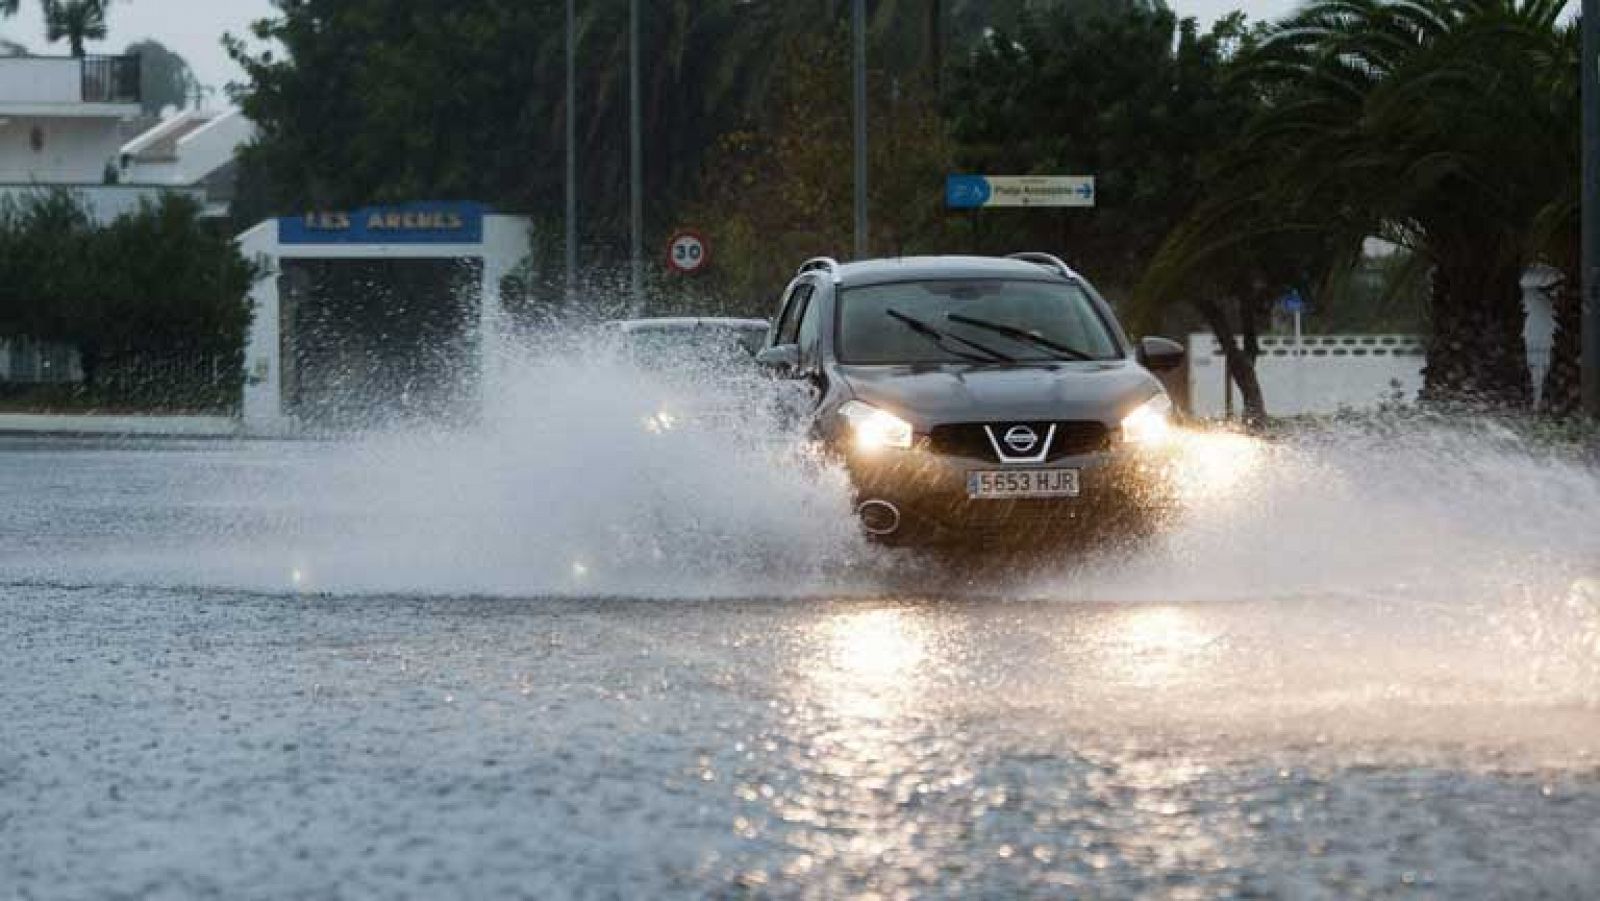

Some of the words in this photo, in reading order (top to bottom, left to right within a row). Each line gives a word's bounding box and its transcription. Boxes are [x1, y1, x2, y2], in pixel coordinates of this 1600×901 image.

[306, 210, 349, 228] LES
[677, 244, 700, 260] 30
[982, 473, 1030, 493] 5653
[1037, 472, 1074, 491] HJR
